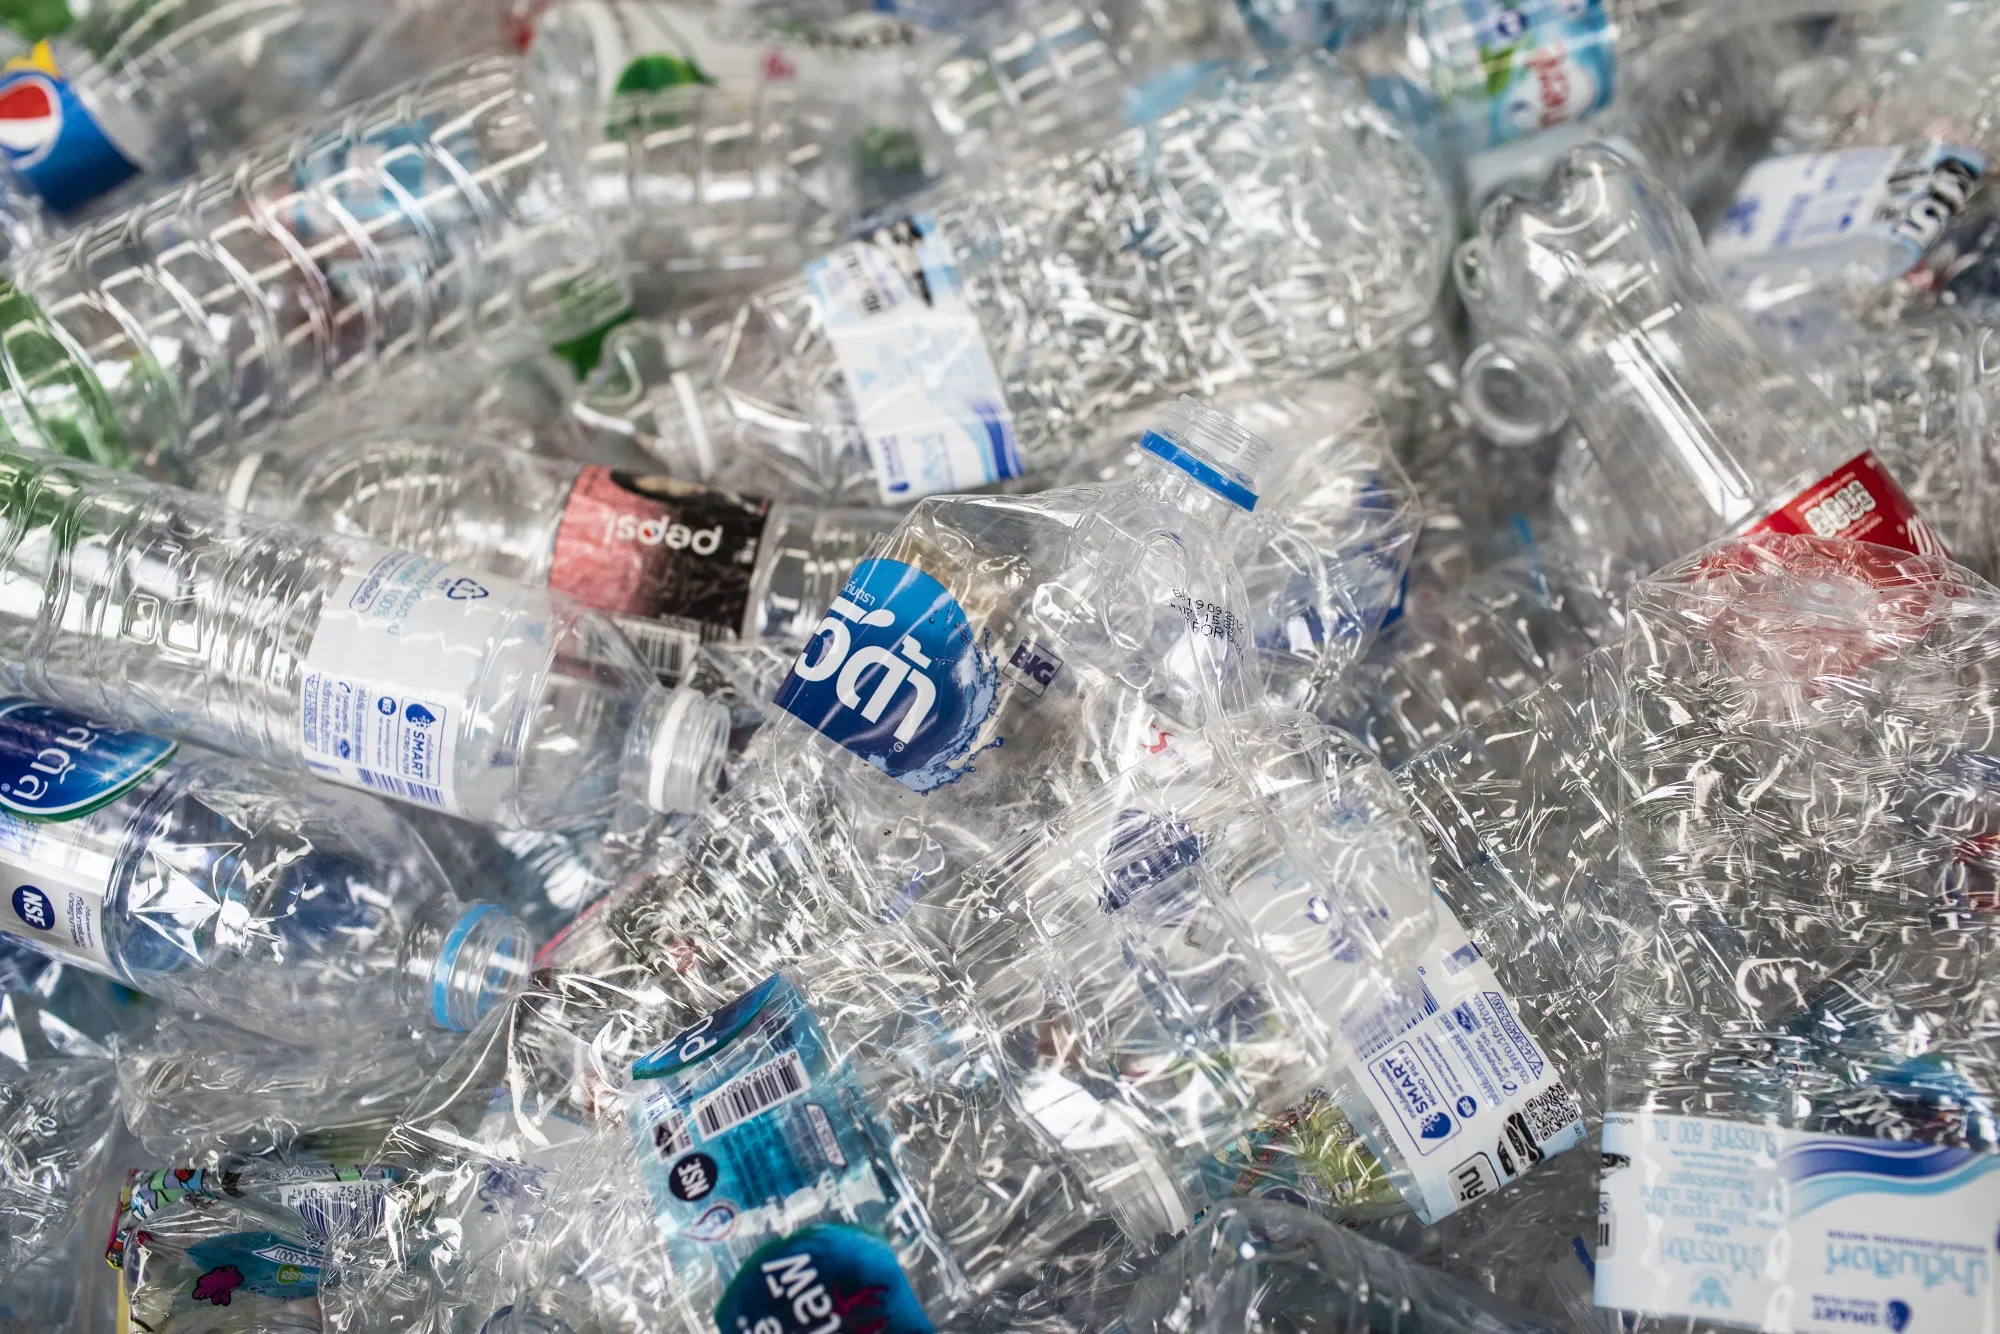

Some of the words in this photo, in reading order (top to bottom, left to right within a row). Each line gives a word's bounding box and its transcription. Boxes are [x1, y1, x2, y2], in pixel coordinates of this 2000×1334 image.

[602, 511, 723, 557] pepsi
[1010, 645, 1055, 686] BIG
[413, 731, 423, 778] SMART
[22, 891, 46, 927] NSF
[674, 1015, 719, 1063] PU
[1489, 993, 1535, 1060] 14-2-00459-2-0001
[744, 1055, 788, 1087] 850124
[1398, 1047, 1419, 1077] FILTER
[1489, 1046, 1504, 1066] Center
[1502, 1066, 1512, 1078] Call
[1384, 1052, 1430, 1115] SMART
[1417, 1076, 1438, 1106] MICRO
[1677, 1120, 1704, 1144] 600
[676, 1157, 711, 1200] NSF
